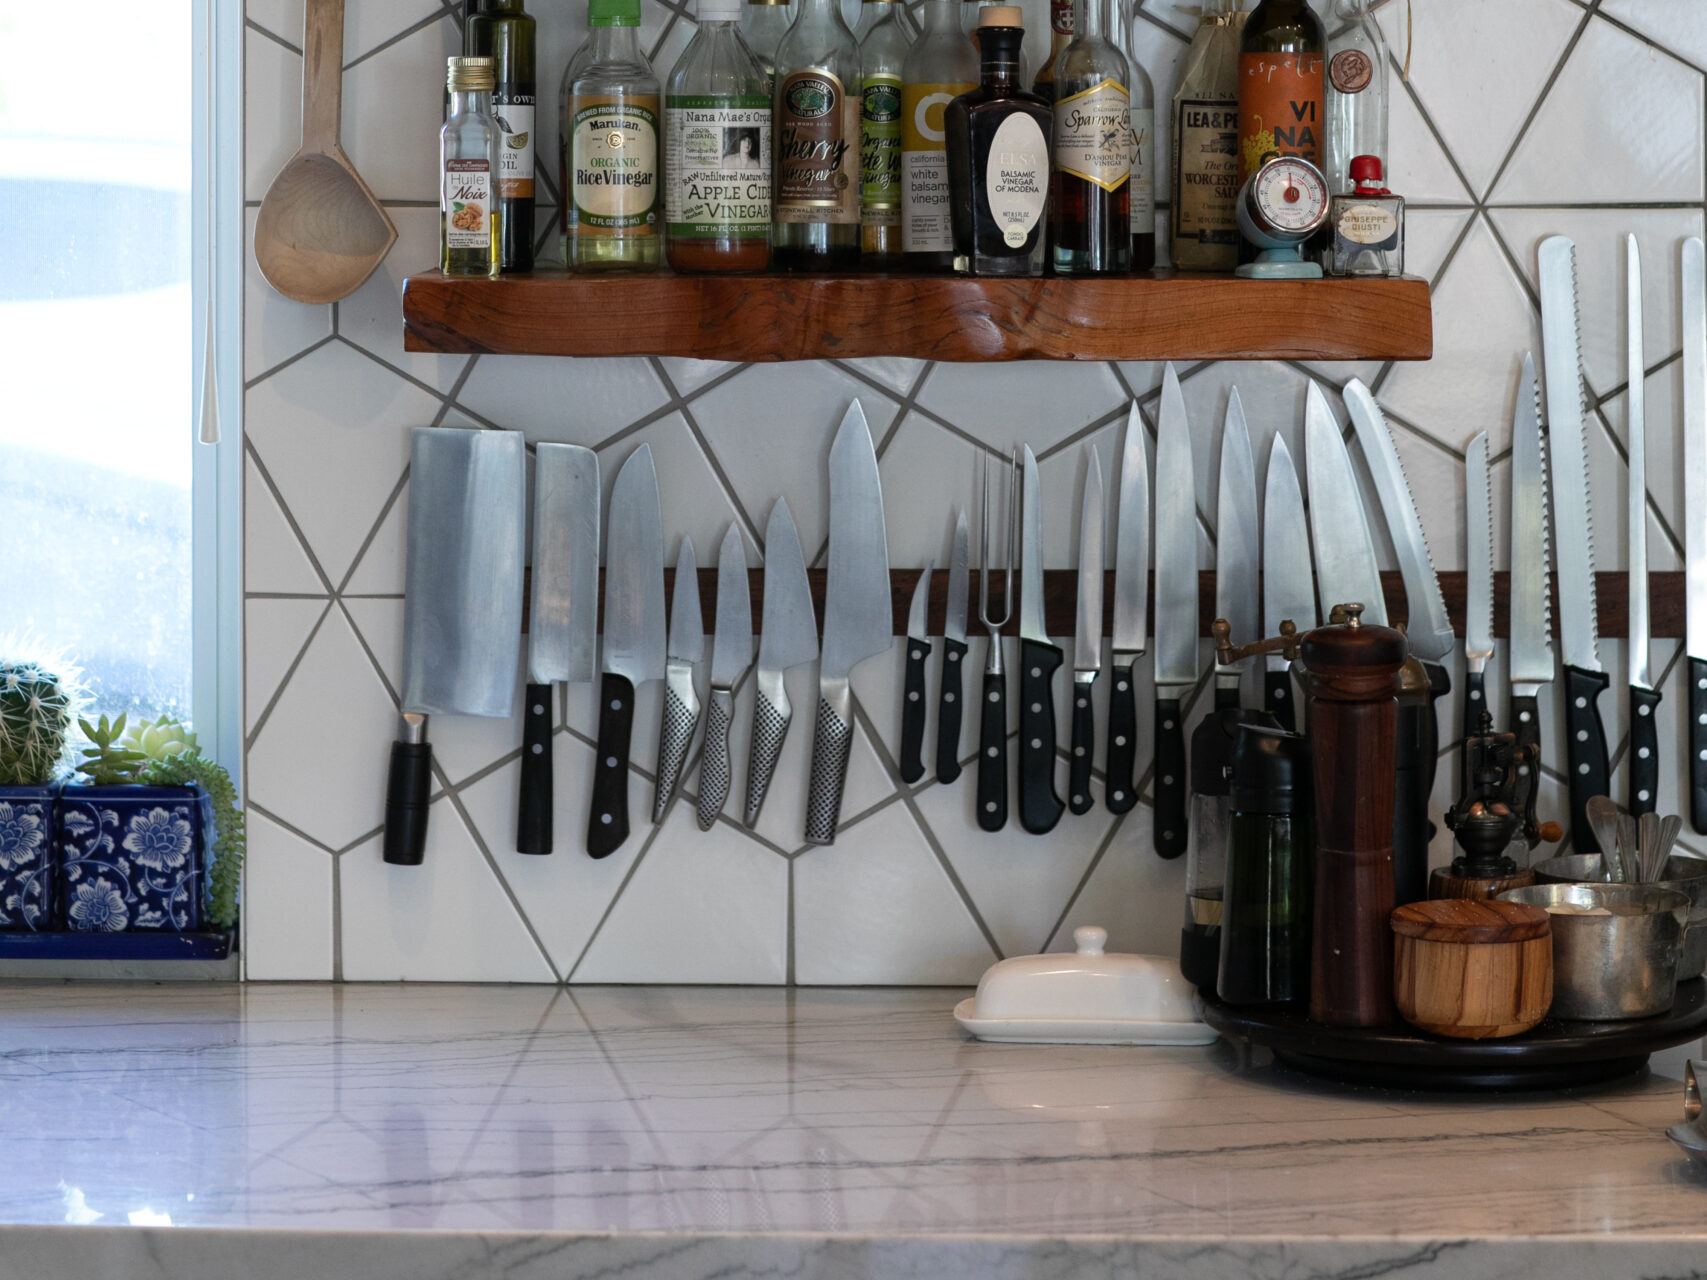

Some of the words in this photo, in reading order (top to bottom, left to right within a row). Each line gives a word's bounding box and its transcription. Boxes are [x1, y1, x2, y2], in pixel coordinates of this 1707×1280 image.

[1249, 59, 1324, 83] espelt
[790, 81, 805, 92] NAPA
[806, 81, 830, 94] VALLEY
[491, 94, 508, 104] r's
[576, 108, 598, 122] BREWED
[598, 106, 615, 114] FROM
[617, 106, 642, 115] ORGANIC
[642, 111, 653, 121] RICE
[686, 111, 715, 122] Nana
[719, 111, 751, 122] Mae's
[793, 106, 827, 117] NATURALS
[1290, 100, 1315, 122] VI
[589, 119, 639, 131] Marukan
[1065, 109, 1118, 133] Sparrow
[1187, 111, 1209, 128] LEA
[1273, 126, 1316, 147] NA
[780, 127, 849, 171] Sherry
[590, 157, 640, 168] ORGANIC
[910, 154, 945, 163] california
[1000, 152, 1037, 165] ELSA
[1084, 153, 1114, 161] D'ANJOU
[1204, 160, 1222, 170] The
[451, 173, 485, 185] Huile
[577, 169, 603, 185] Rice
[603, 169, 653, 187] Vinegar
[682, 171, 700, 186] RAW
[700, 170, 738, 181] Unfiltered
[782, 163, 832, 187] Vinegar
[911, 169, 939, 179] white
[1000, 170, 1036, 178] BALSAMIC
[1184, 173, 1238, 186] WORCEST
[911, 181, 949, 192] balsam
[1002, 178, 1034, 186] VINEGAR
[448, 185, 489, 200] Noix
[688, 184, 741, 200] APPLE
[746, 183, 771, 200] CIDE
[995, 185, 1005, 193] OF
[1007, 185, 1039, 193] MODENA
[1214, 186, 1238, 199] SAU
[705, 202, 769, 218] VINEGAR
[816, 206, 844, 214] KITCHEN
[597, 217, 605, 225] FL
